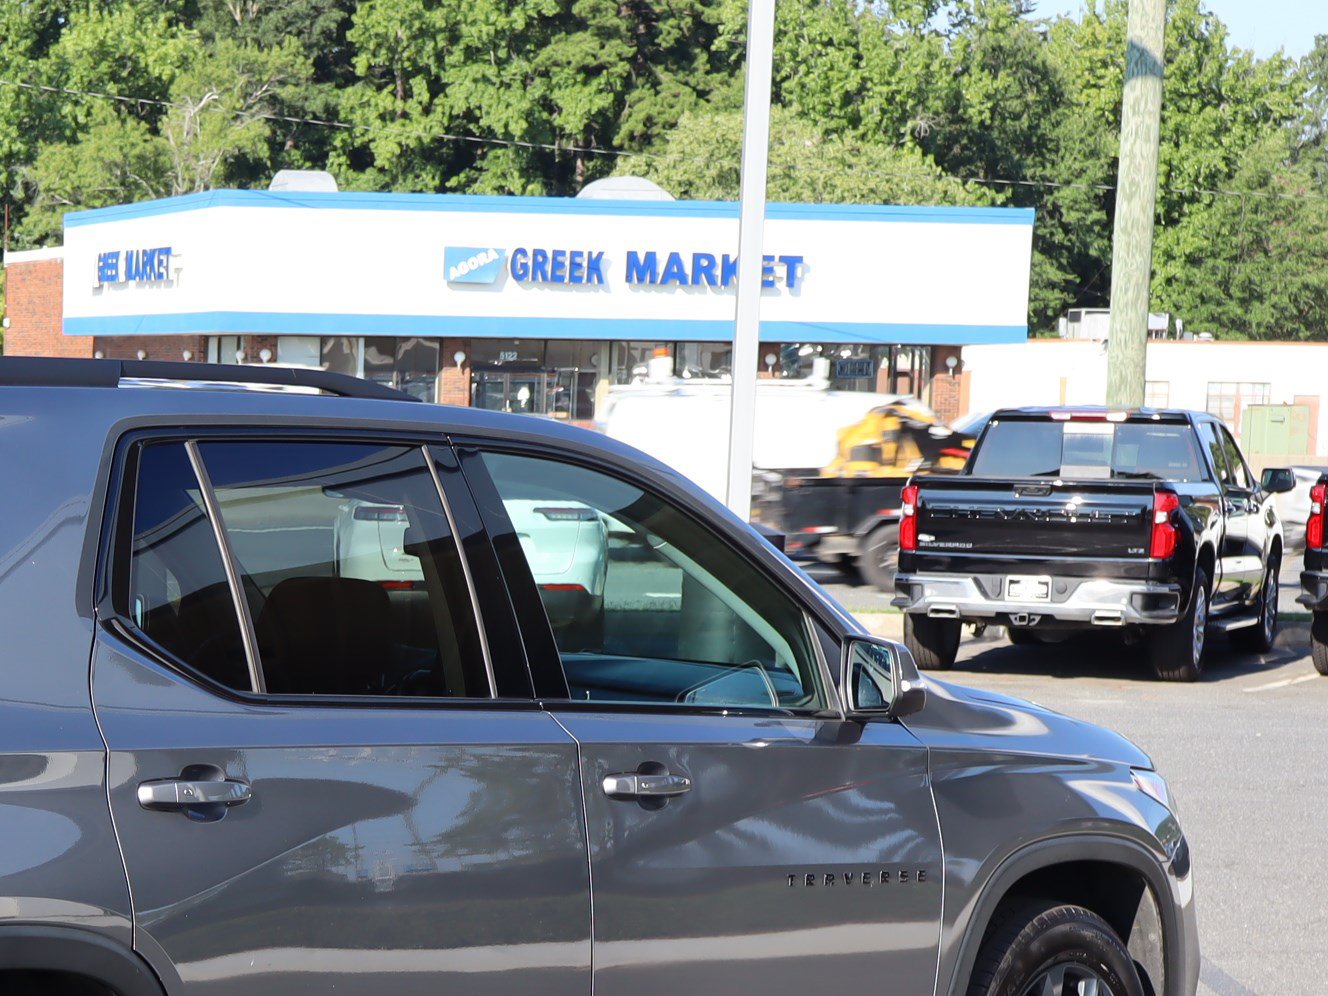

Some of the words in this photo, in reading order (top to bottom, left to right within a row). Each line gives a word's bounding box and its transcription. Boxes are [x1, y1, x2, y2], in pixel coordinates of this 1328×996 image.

[125, 246, 172, 281] MARKET
[449, 248, 500, 280] AGORA
[510, 247, 605, 284] GREEK
[625, 250, 804, 288] MARKET
[787, 870, 927, 888] TRAVERSE
